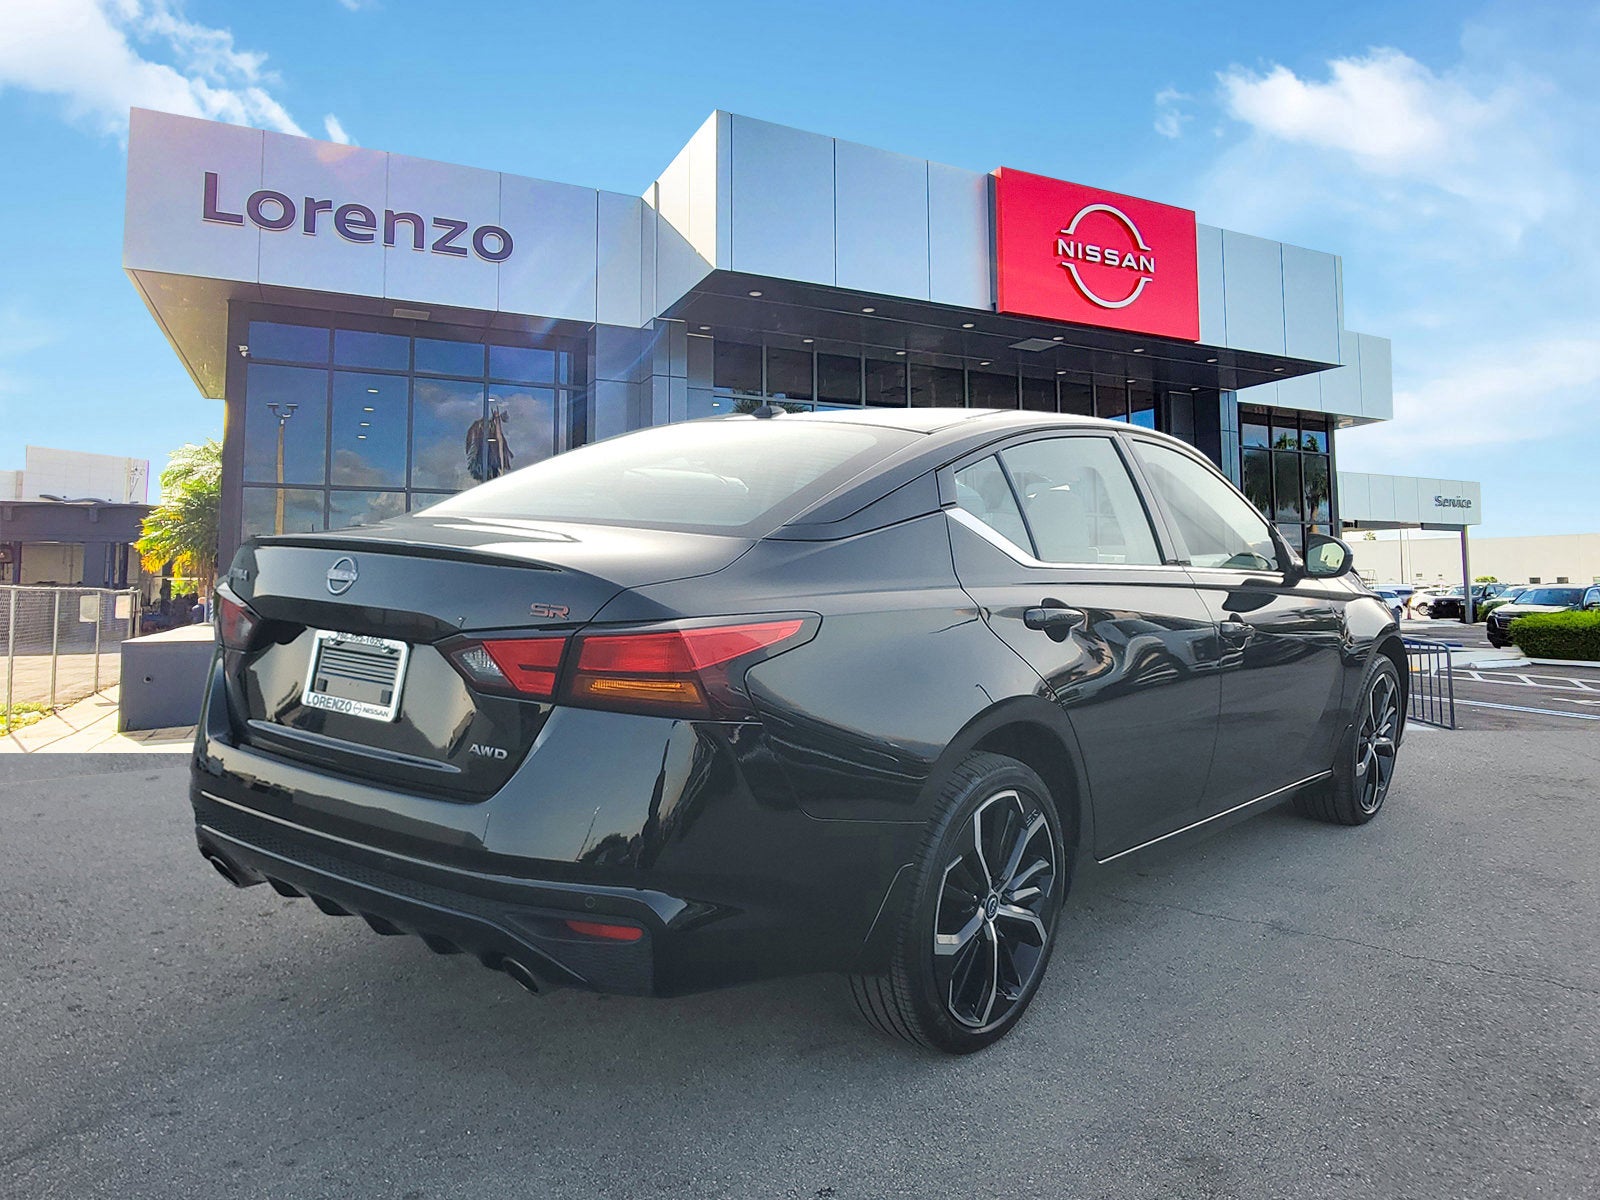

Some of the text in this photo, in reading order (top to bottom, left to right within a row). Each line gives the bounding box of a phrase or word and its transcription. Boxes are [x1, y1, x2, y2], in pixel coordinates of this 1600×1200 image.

[202, 170, 514, 262] Lorenzo
[1056, 237, 1156, 274] NISSAN
[1433, 495, 1473, 509] Service
[529, 602, 570, 621] SR
[305, 692, 390, 719] LORENZO NISSAN
[468, 743, 508, 760] AWD
